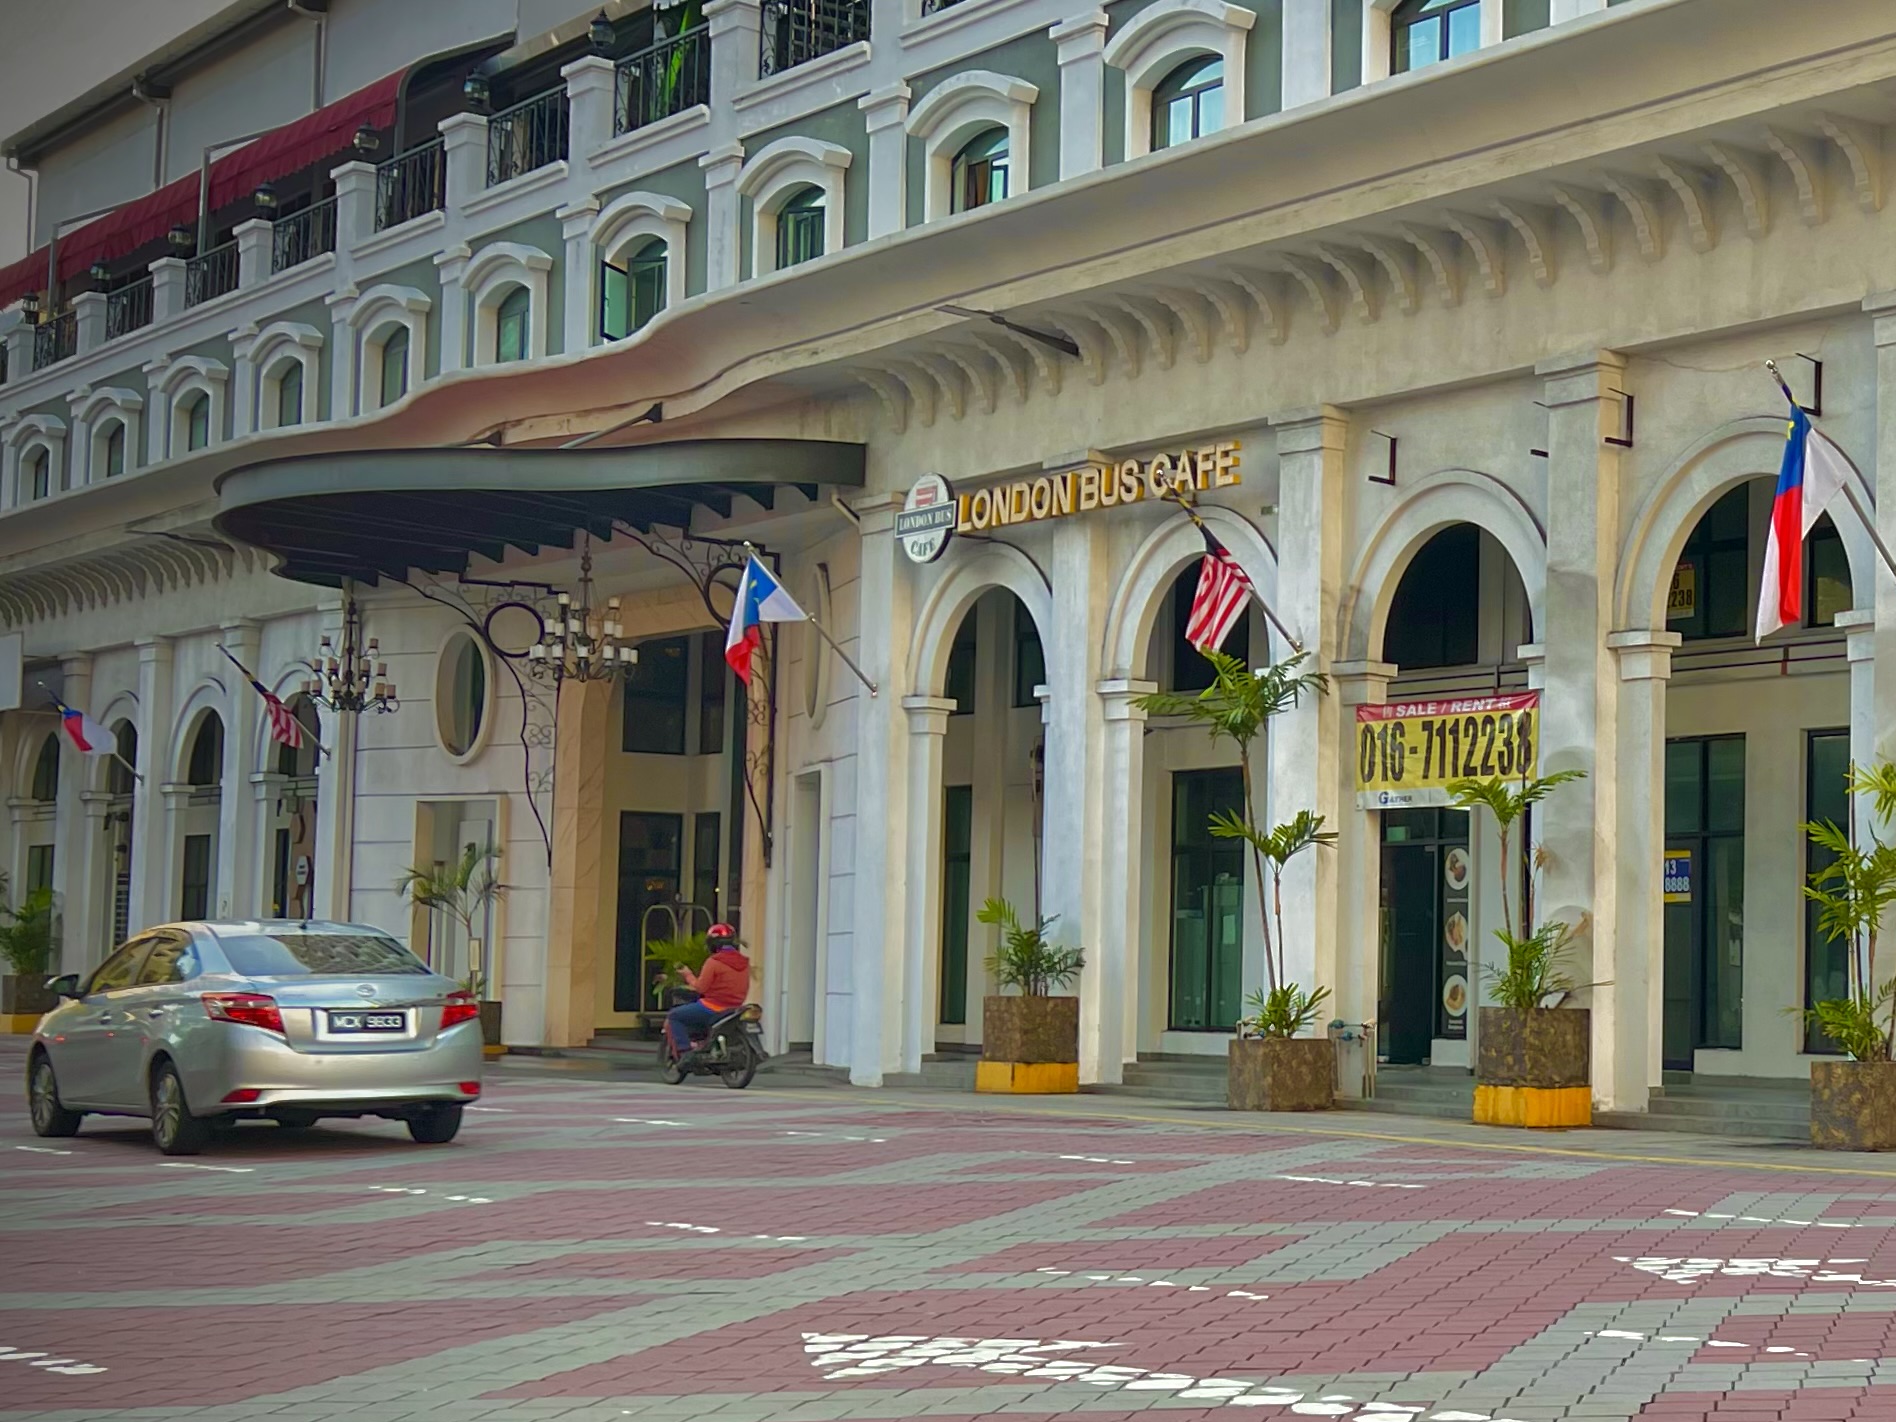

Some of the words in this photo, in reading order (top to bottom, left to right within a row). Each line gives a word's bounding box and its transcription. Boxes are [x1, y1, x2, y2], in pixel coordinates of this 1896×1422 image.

[957, 471, 1079, 532] LONDON
[1080, 458, 1145, 511] BUS
[1150, 439, 1242, 498] CAFE
[899, 512, 934, 531] LONDON
[934, 508, 952, 524] BUS
[1395, 702, 1436, 717] SALE
[1450, 698, 1496, 712] RENT
[1360, 711, 1532, 783] 016-7112238
